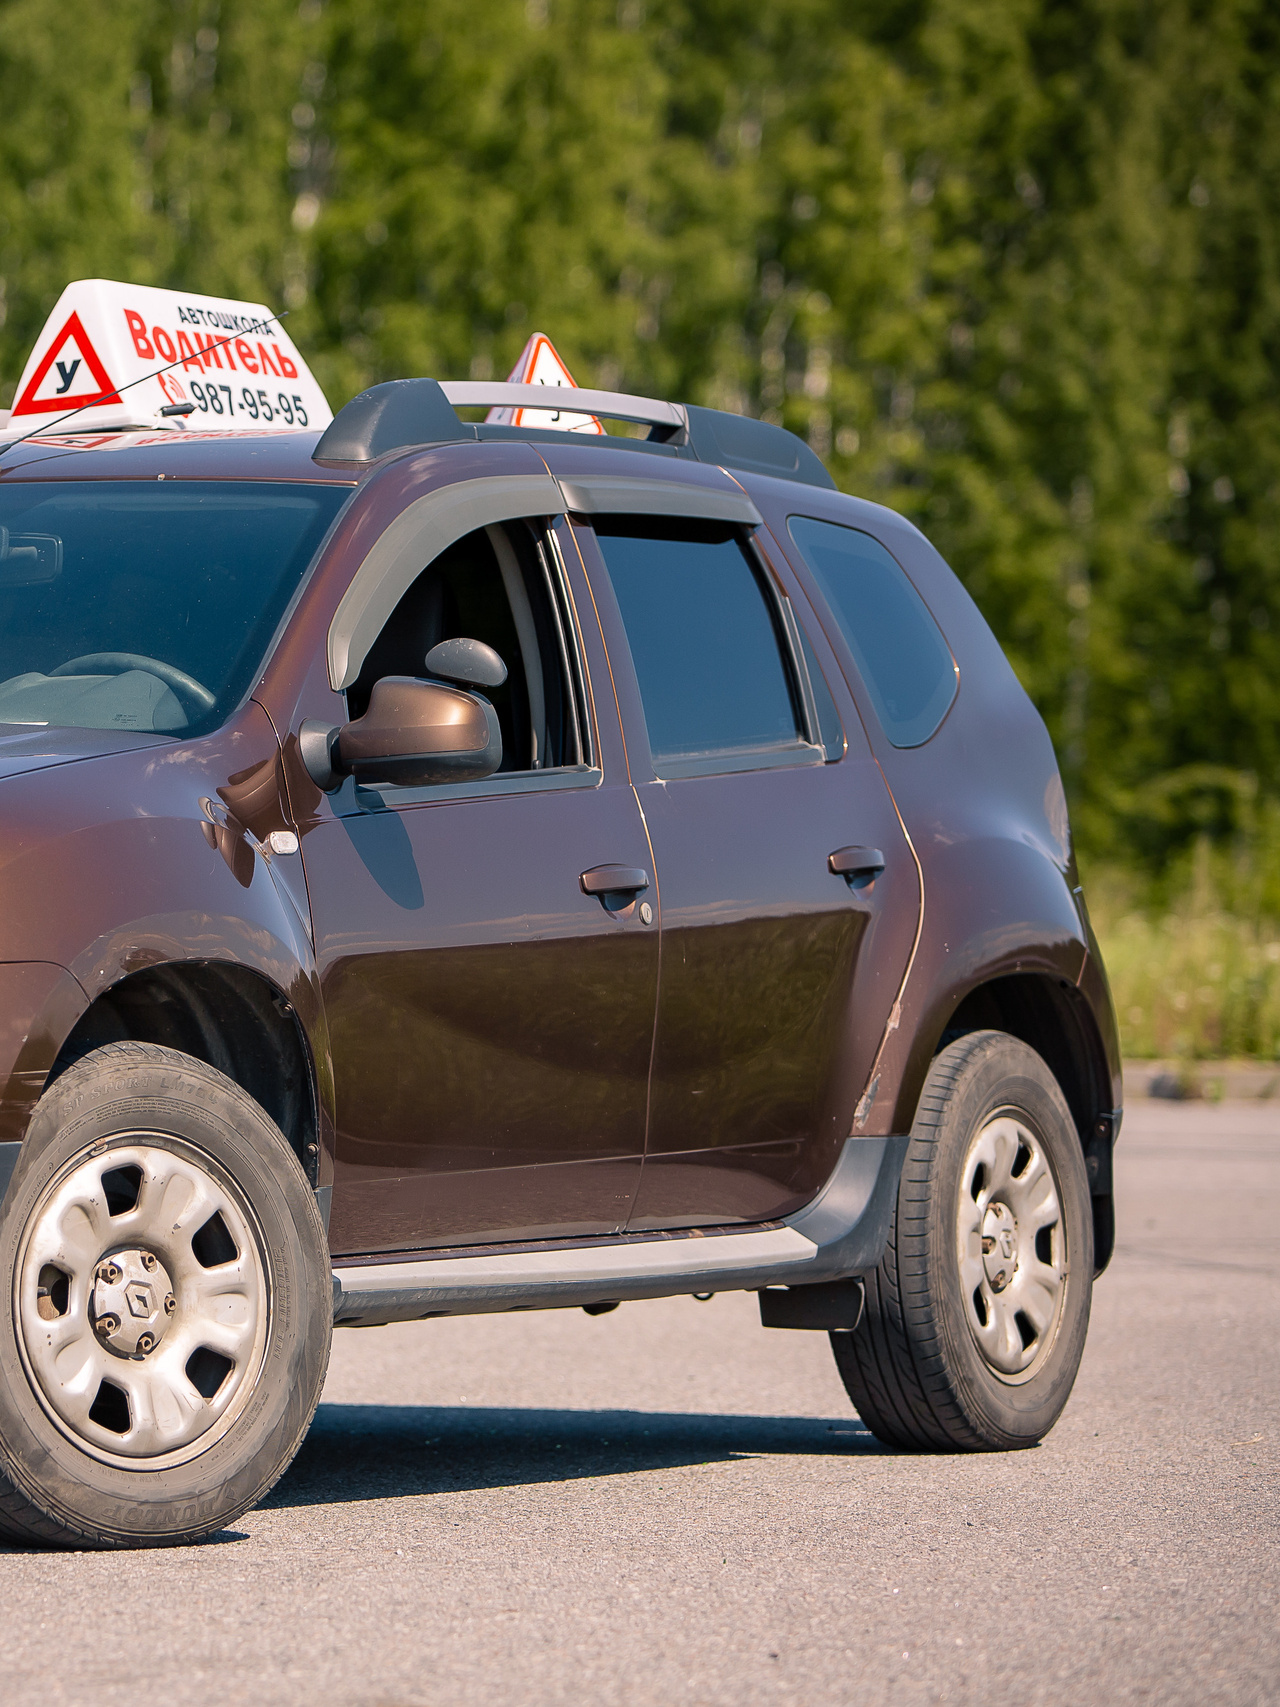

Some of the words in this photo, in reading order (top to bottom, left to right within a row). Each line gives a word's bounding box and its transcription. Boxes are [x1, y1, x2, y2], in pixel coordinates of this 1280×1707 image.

[177, 306, 275, 337] АВТОШКОЛА
[189, 380, 309, 428] 987-95-95
[101, 1495, 216, 1526] DUNLOP
